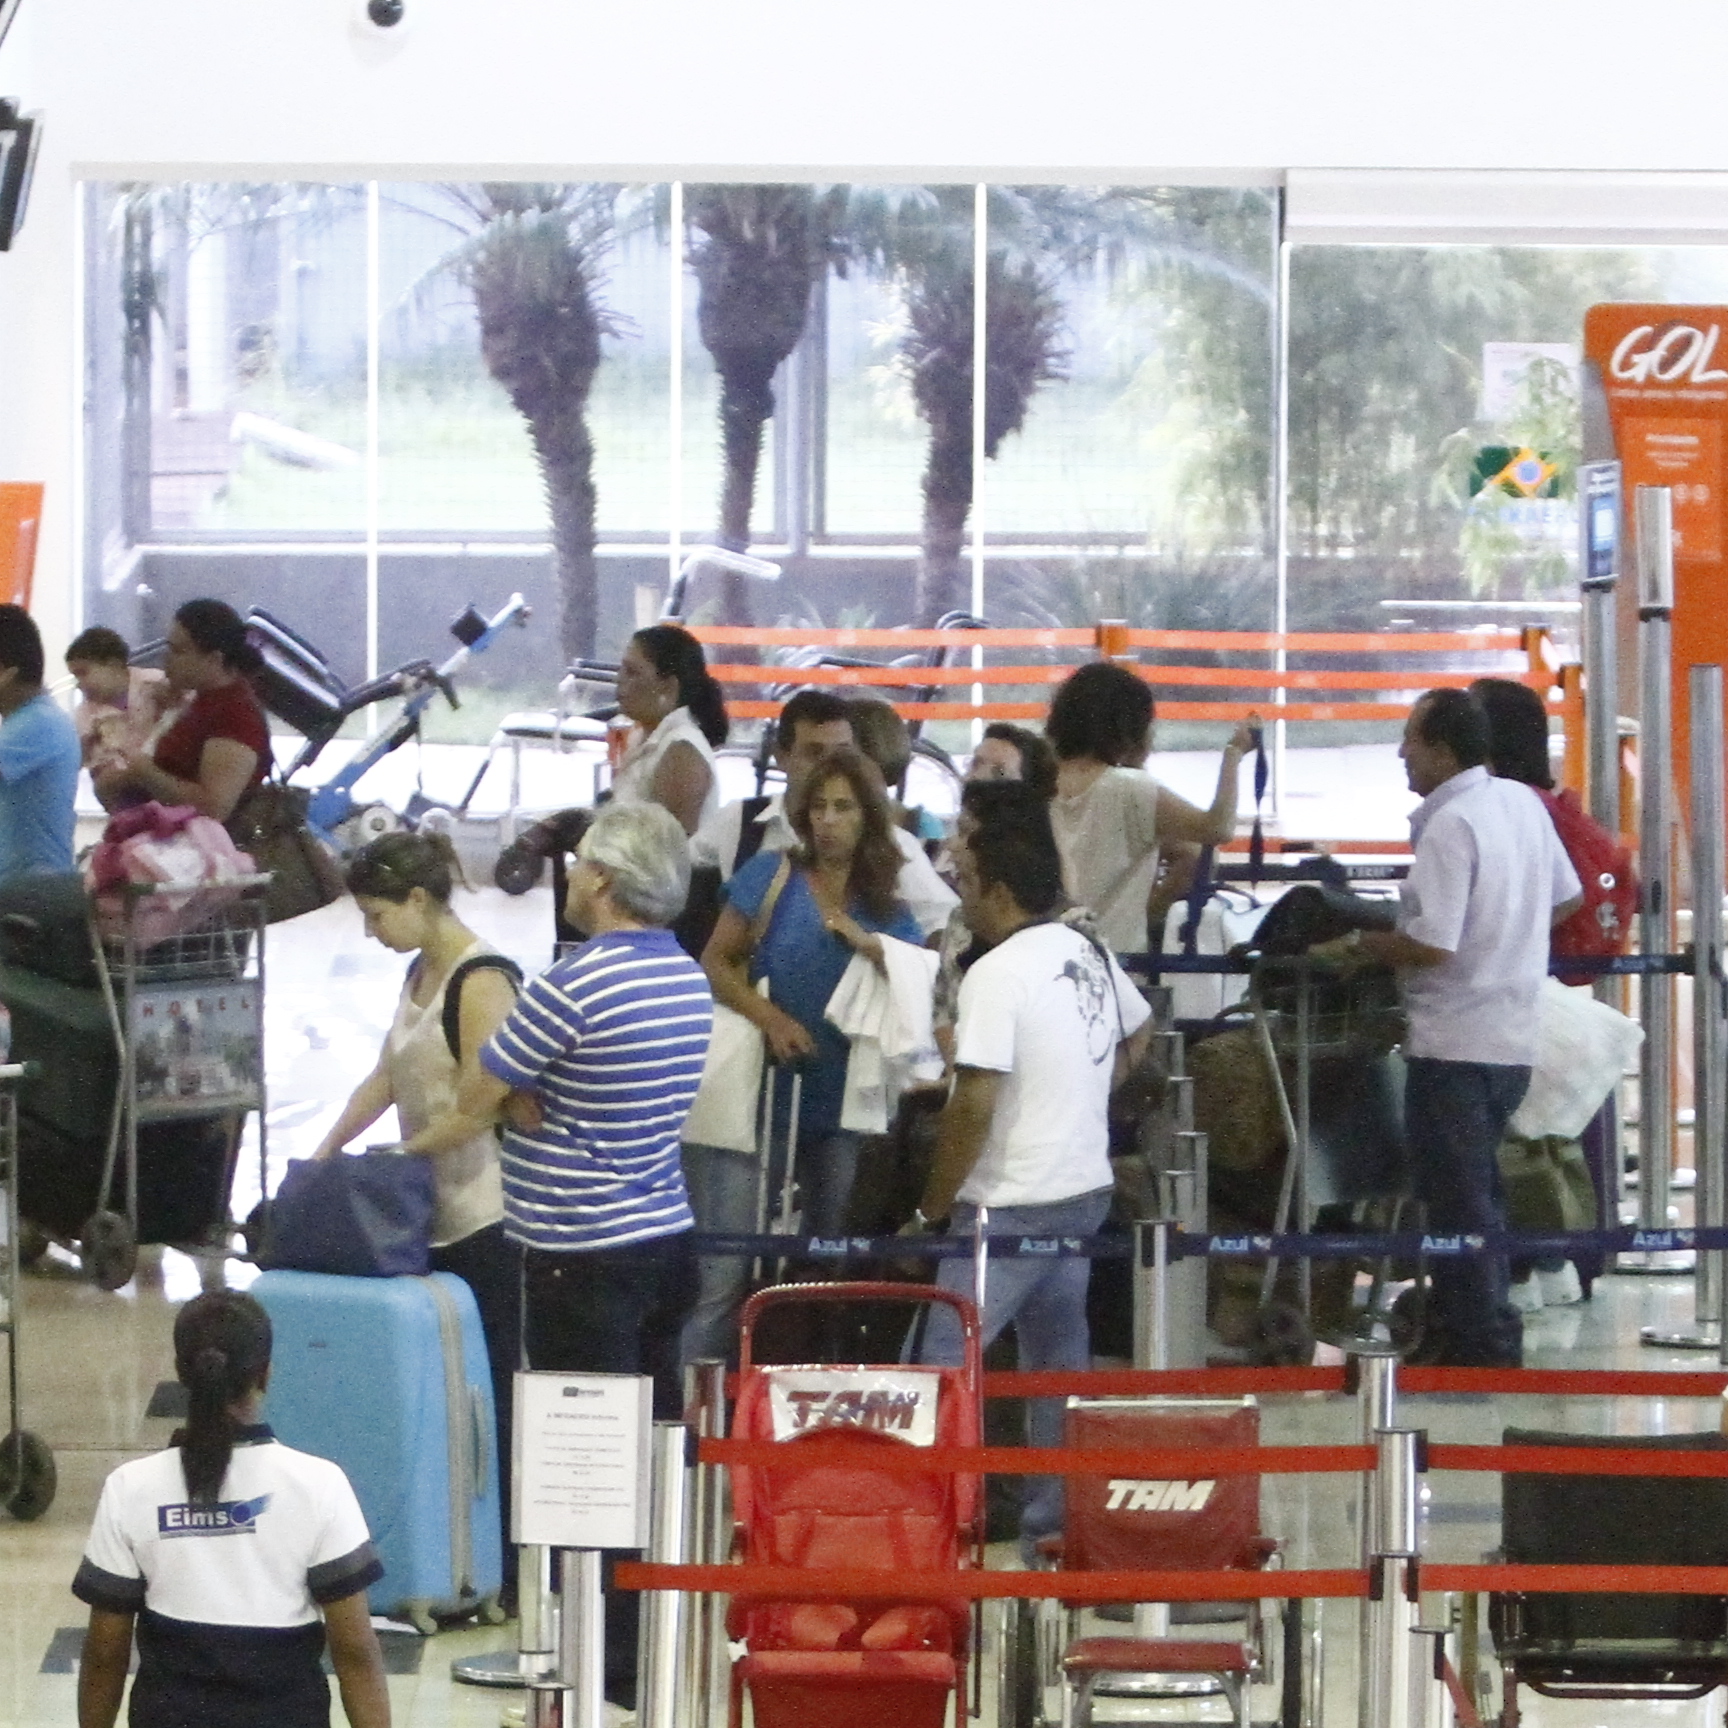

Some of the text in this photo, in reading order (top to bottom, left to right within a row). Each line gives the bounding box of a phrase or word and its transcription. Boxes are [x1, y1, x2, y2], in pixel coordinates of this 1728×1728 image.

[1209, 1236, 1249, 1252] Azul
[1422, 1235, 1461, 1251] Azul
[1633, 1230, 1672, 1249] Azul
[1106, 1479, 1216, 1511] TAM
